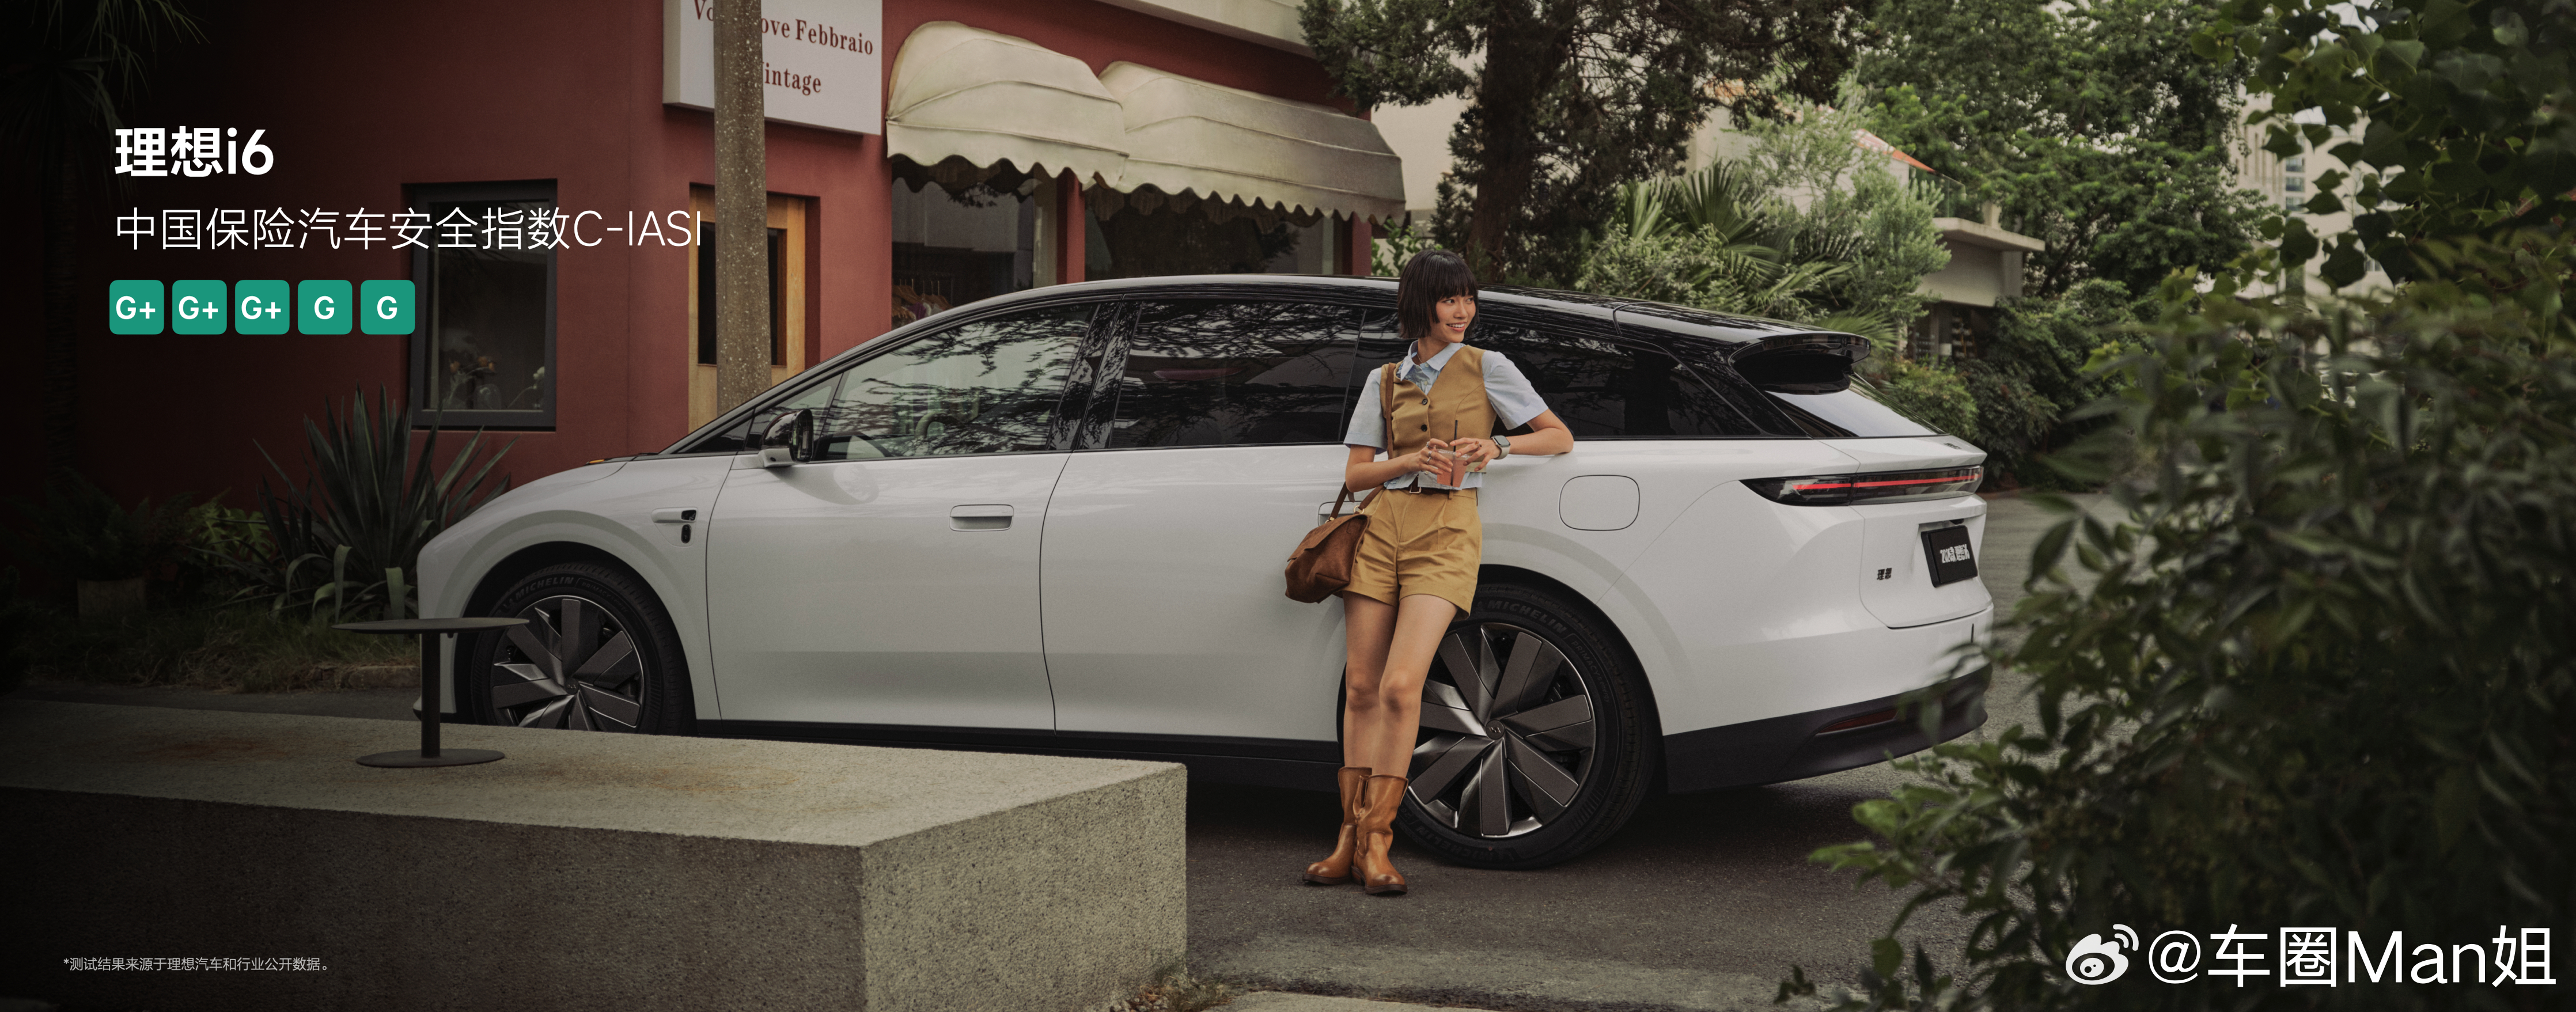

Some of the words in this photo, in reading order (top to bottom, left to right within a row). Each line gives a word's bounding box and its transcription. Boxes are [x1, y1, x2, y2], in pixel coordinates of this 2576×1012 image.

[795, 18, 873, 55] Febbraio
[762, 62, 821, 96] intage
[514, 576, 574, 600] MICHELIN
[582, 582, 611, 597] PRIMACY
[1487, 600, 1567, 634] MICHELIN
[1571, 640, 1600, 675] PRIMACY
